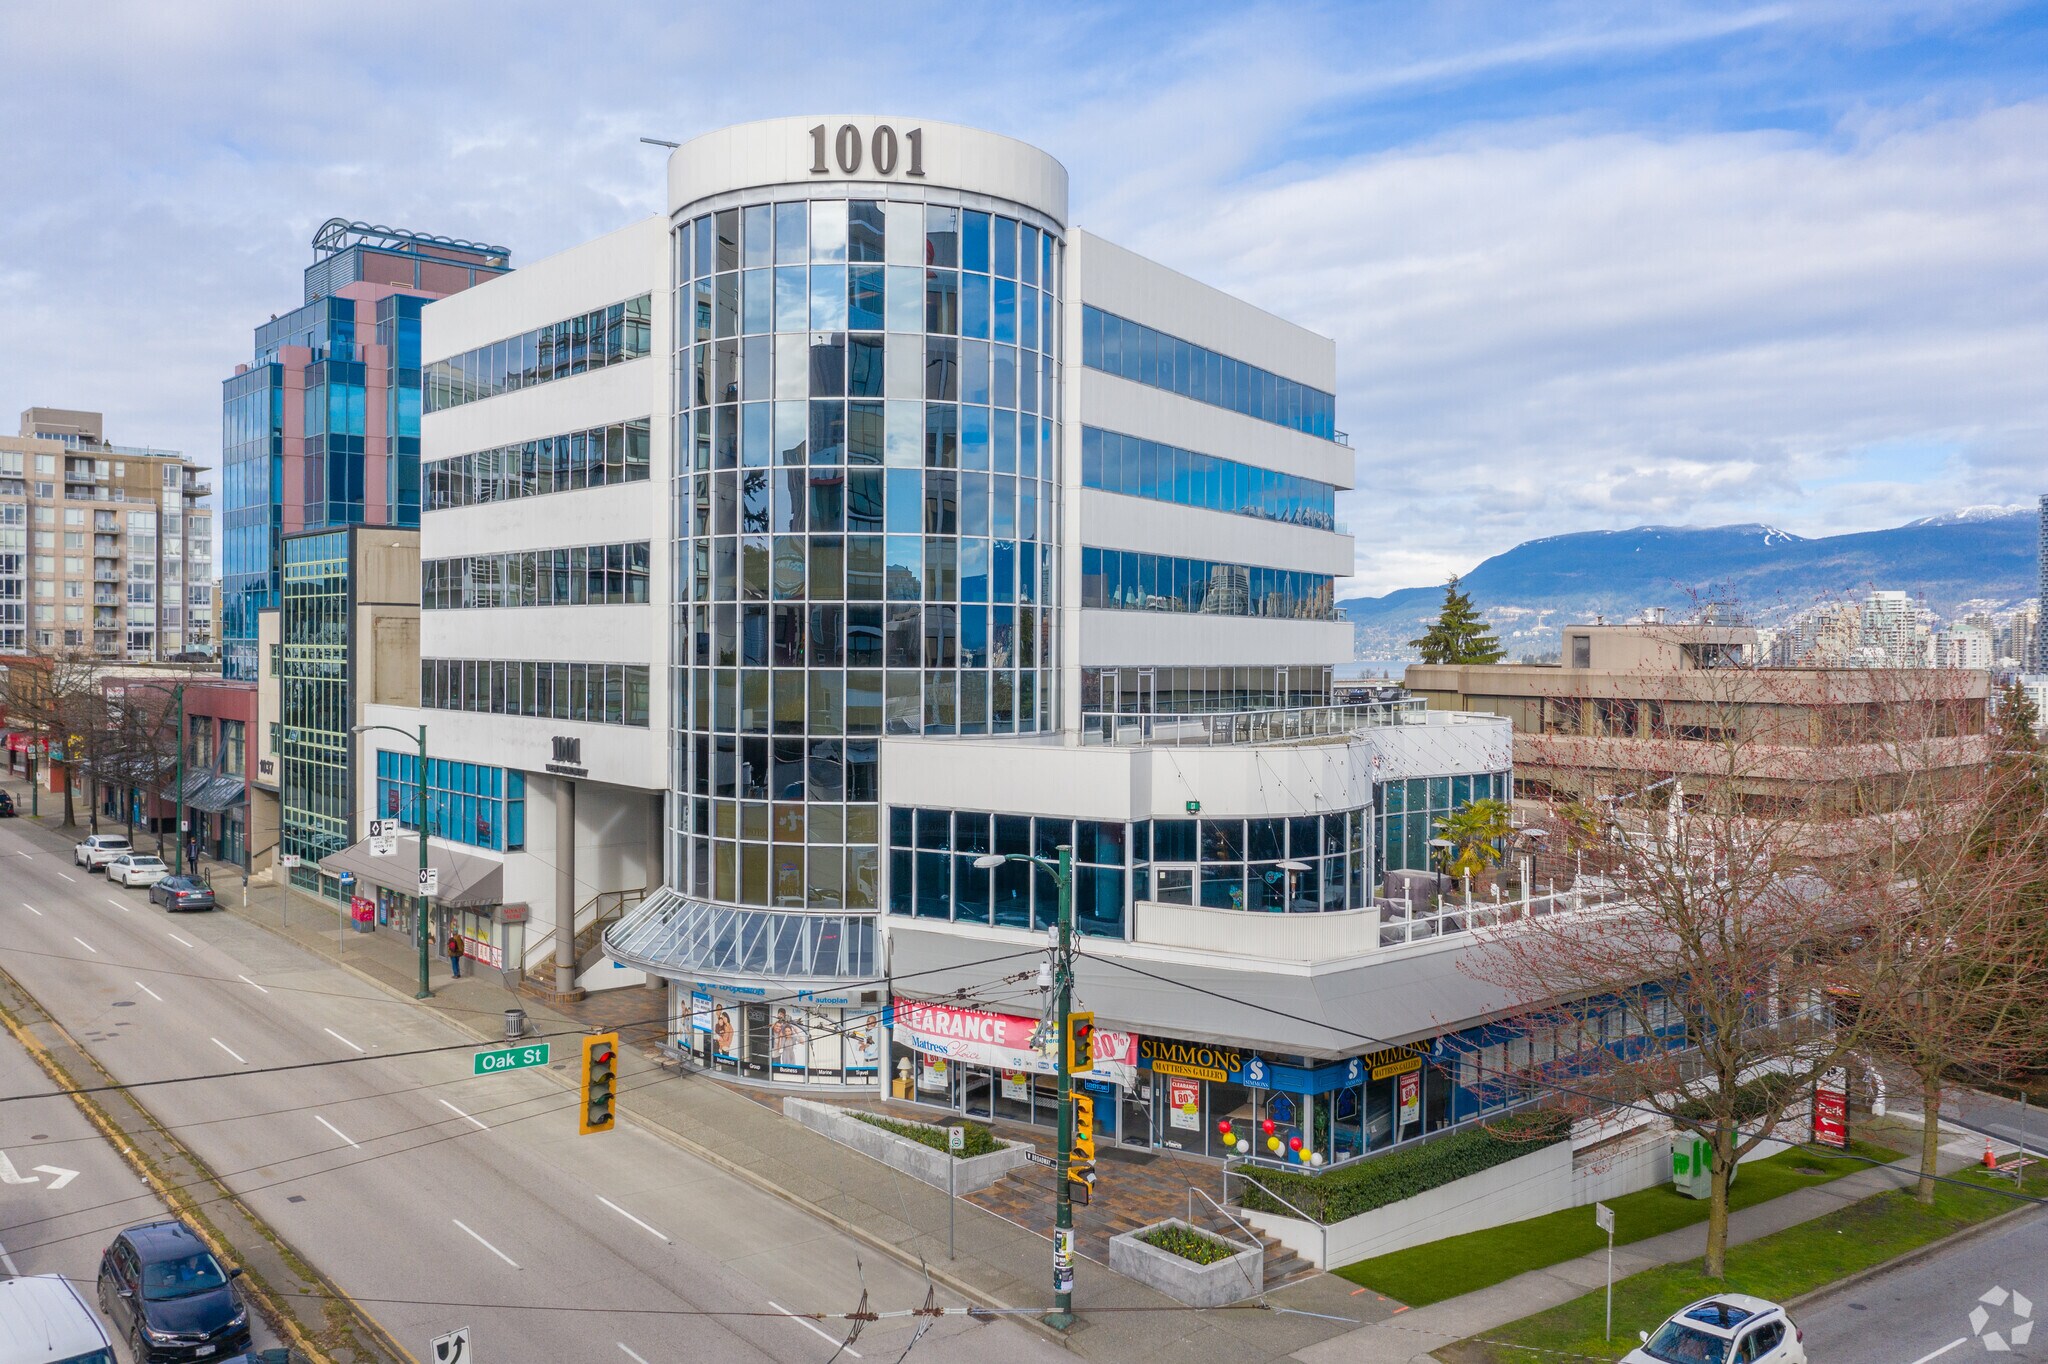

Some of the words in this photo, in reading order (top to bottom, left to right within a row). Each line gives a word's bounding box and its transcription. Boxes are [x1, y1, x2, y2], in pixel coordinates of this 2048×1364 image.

[809, 123, 926, 176] 1001
[260, 759, 275, 776] 1037
[911, 1034, 948, 1054] Mattress
[945, 1040, 982, 1060] Choice
[1364, 1039, 1431, 1071] SIMMONS
[482, 1052, 516, 1070] Oak
[523, 1049, 542, 1065] St
[1141, 1040, 1241, 1073] SIMMONS
[749, 1063, 761, 1071] Group
[1155, 1062, 1192, 1076] MATTRESS
[1192, 1066, 1225, 1080] GALLERY
[1374, 1064, 1399, 1078] MATTRESS
[1399, 1059, 1420, 1072] GALLERY
[1172, 1081, 1198, 1090] CLEARANCE
[1818, 1102, 1843, 1116] Park
[1032, 1154, 1051, 1166] BROADWAY
